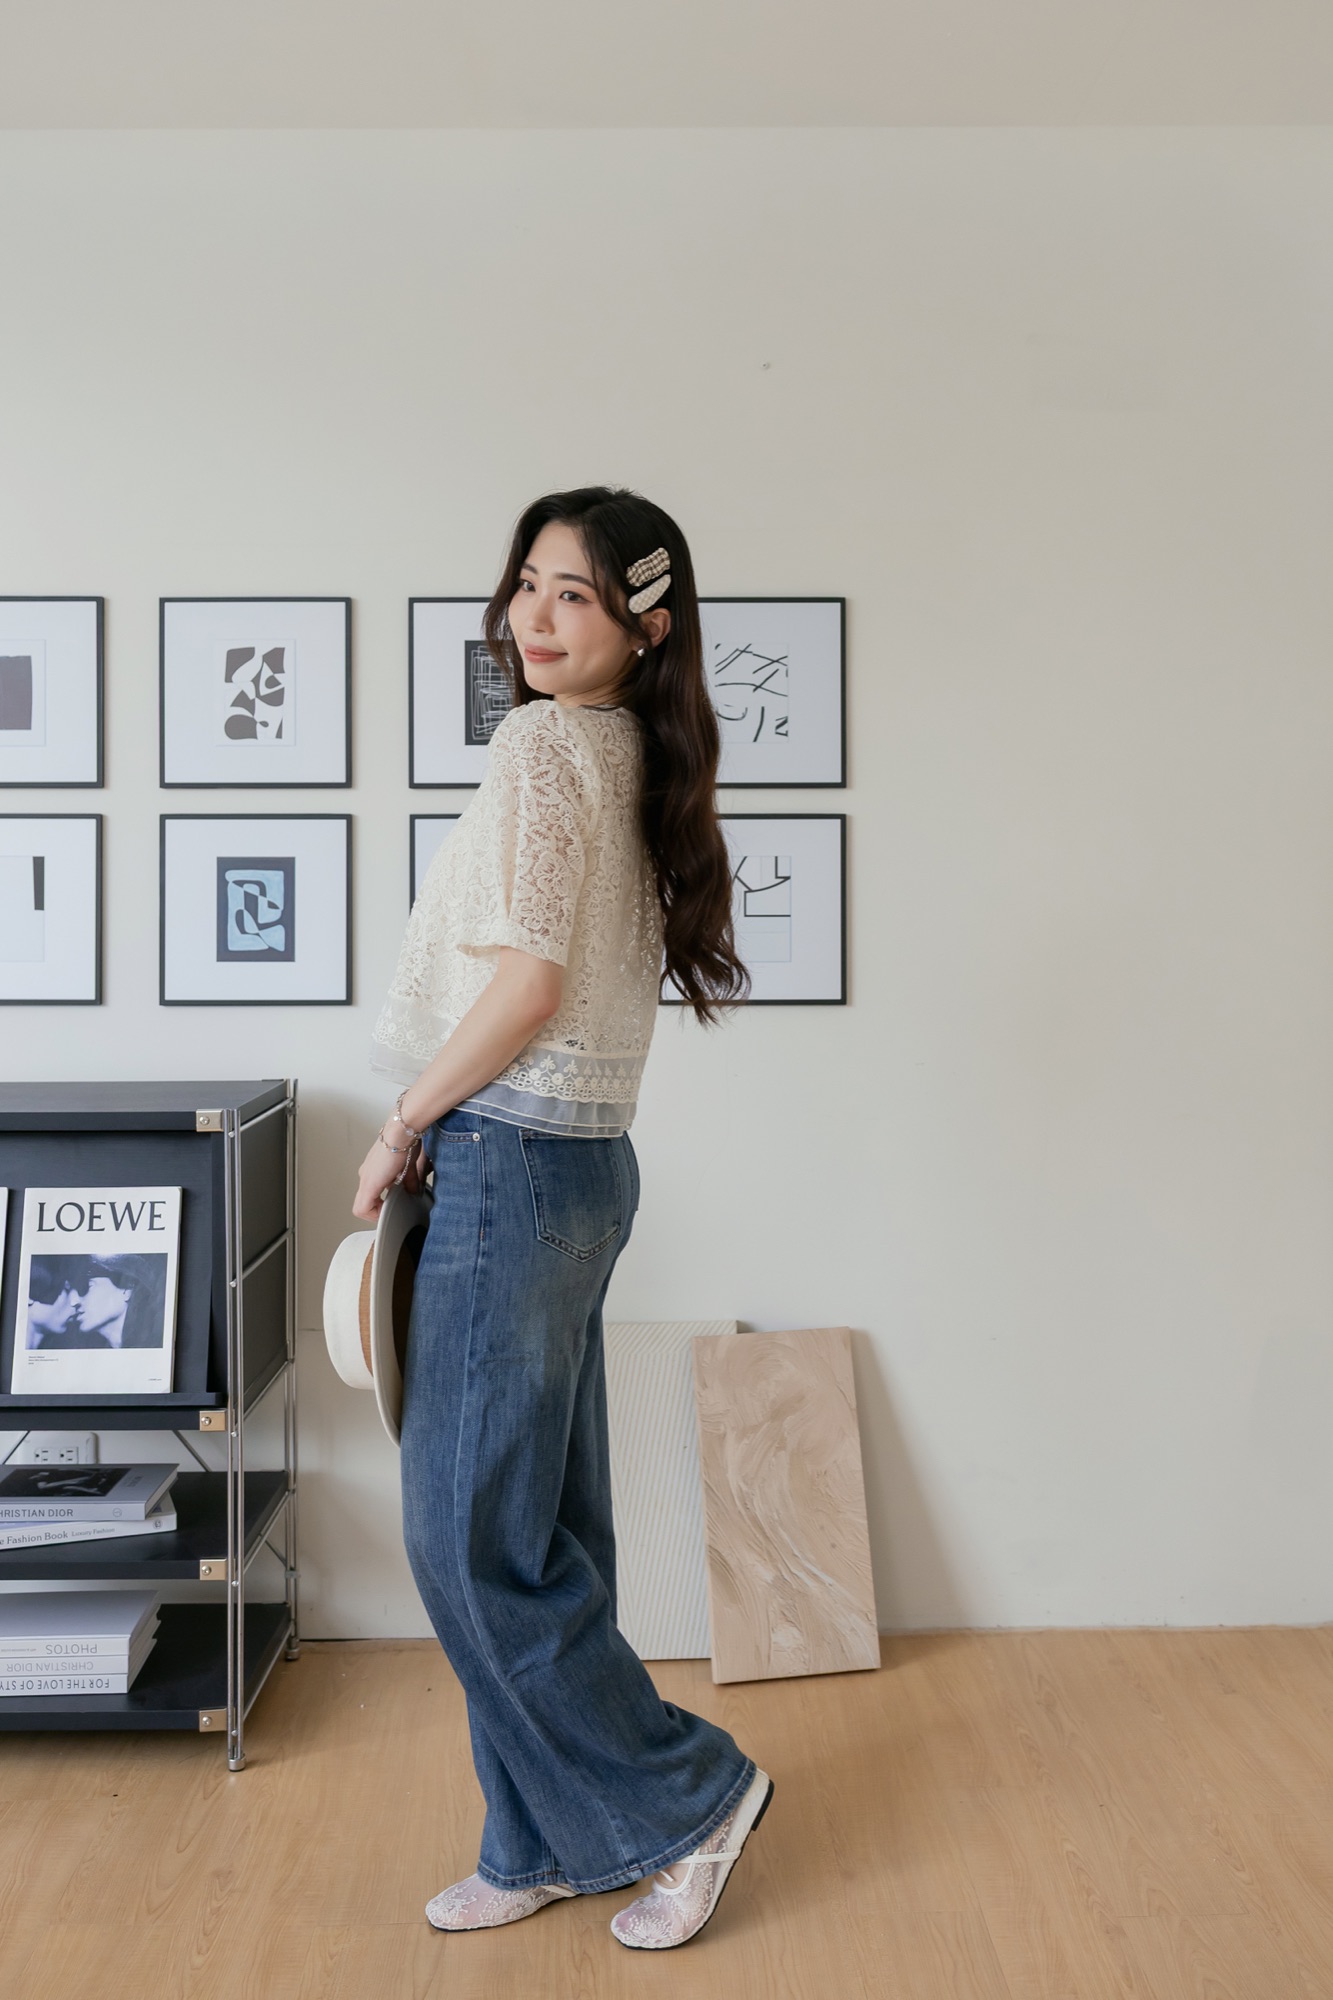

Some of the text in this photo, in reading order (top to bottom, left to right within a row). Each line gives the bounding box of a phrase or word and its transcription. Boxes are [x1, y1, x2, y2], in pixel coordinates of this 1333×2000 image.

[37, 1201, 166, 1232] LOEWE
[48, 1508, 74, 1517] DIOR
[7, 1535, 42, 1544] Fashion
[44, 1531, 69, 1540] Book
[45, 1644, 98, 1654] PHOTOS
[6, 1662, 94, 1672] CHRISTIAN DIOR
[20, 1679, 34, 1691] OF
[37, 1679, 64, 1690] LOVE
[67, 1679, 86, 1689] THE
[88, 1678, 110, 1689] FOR
